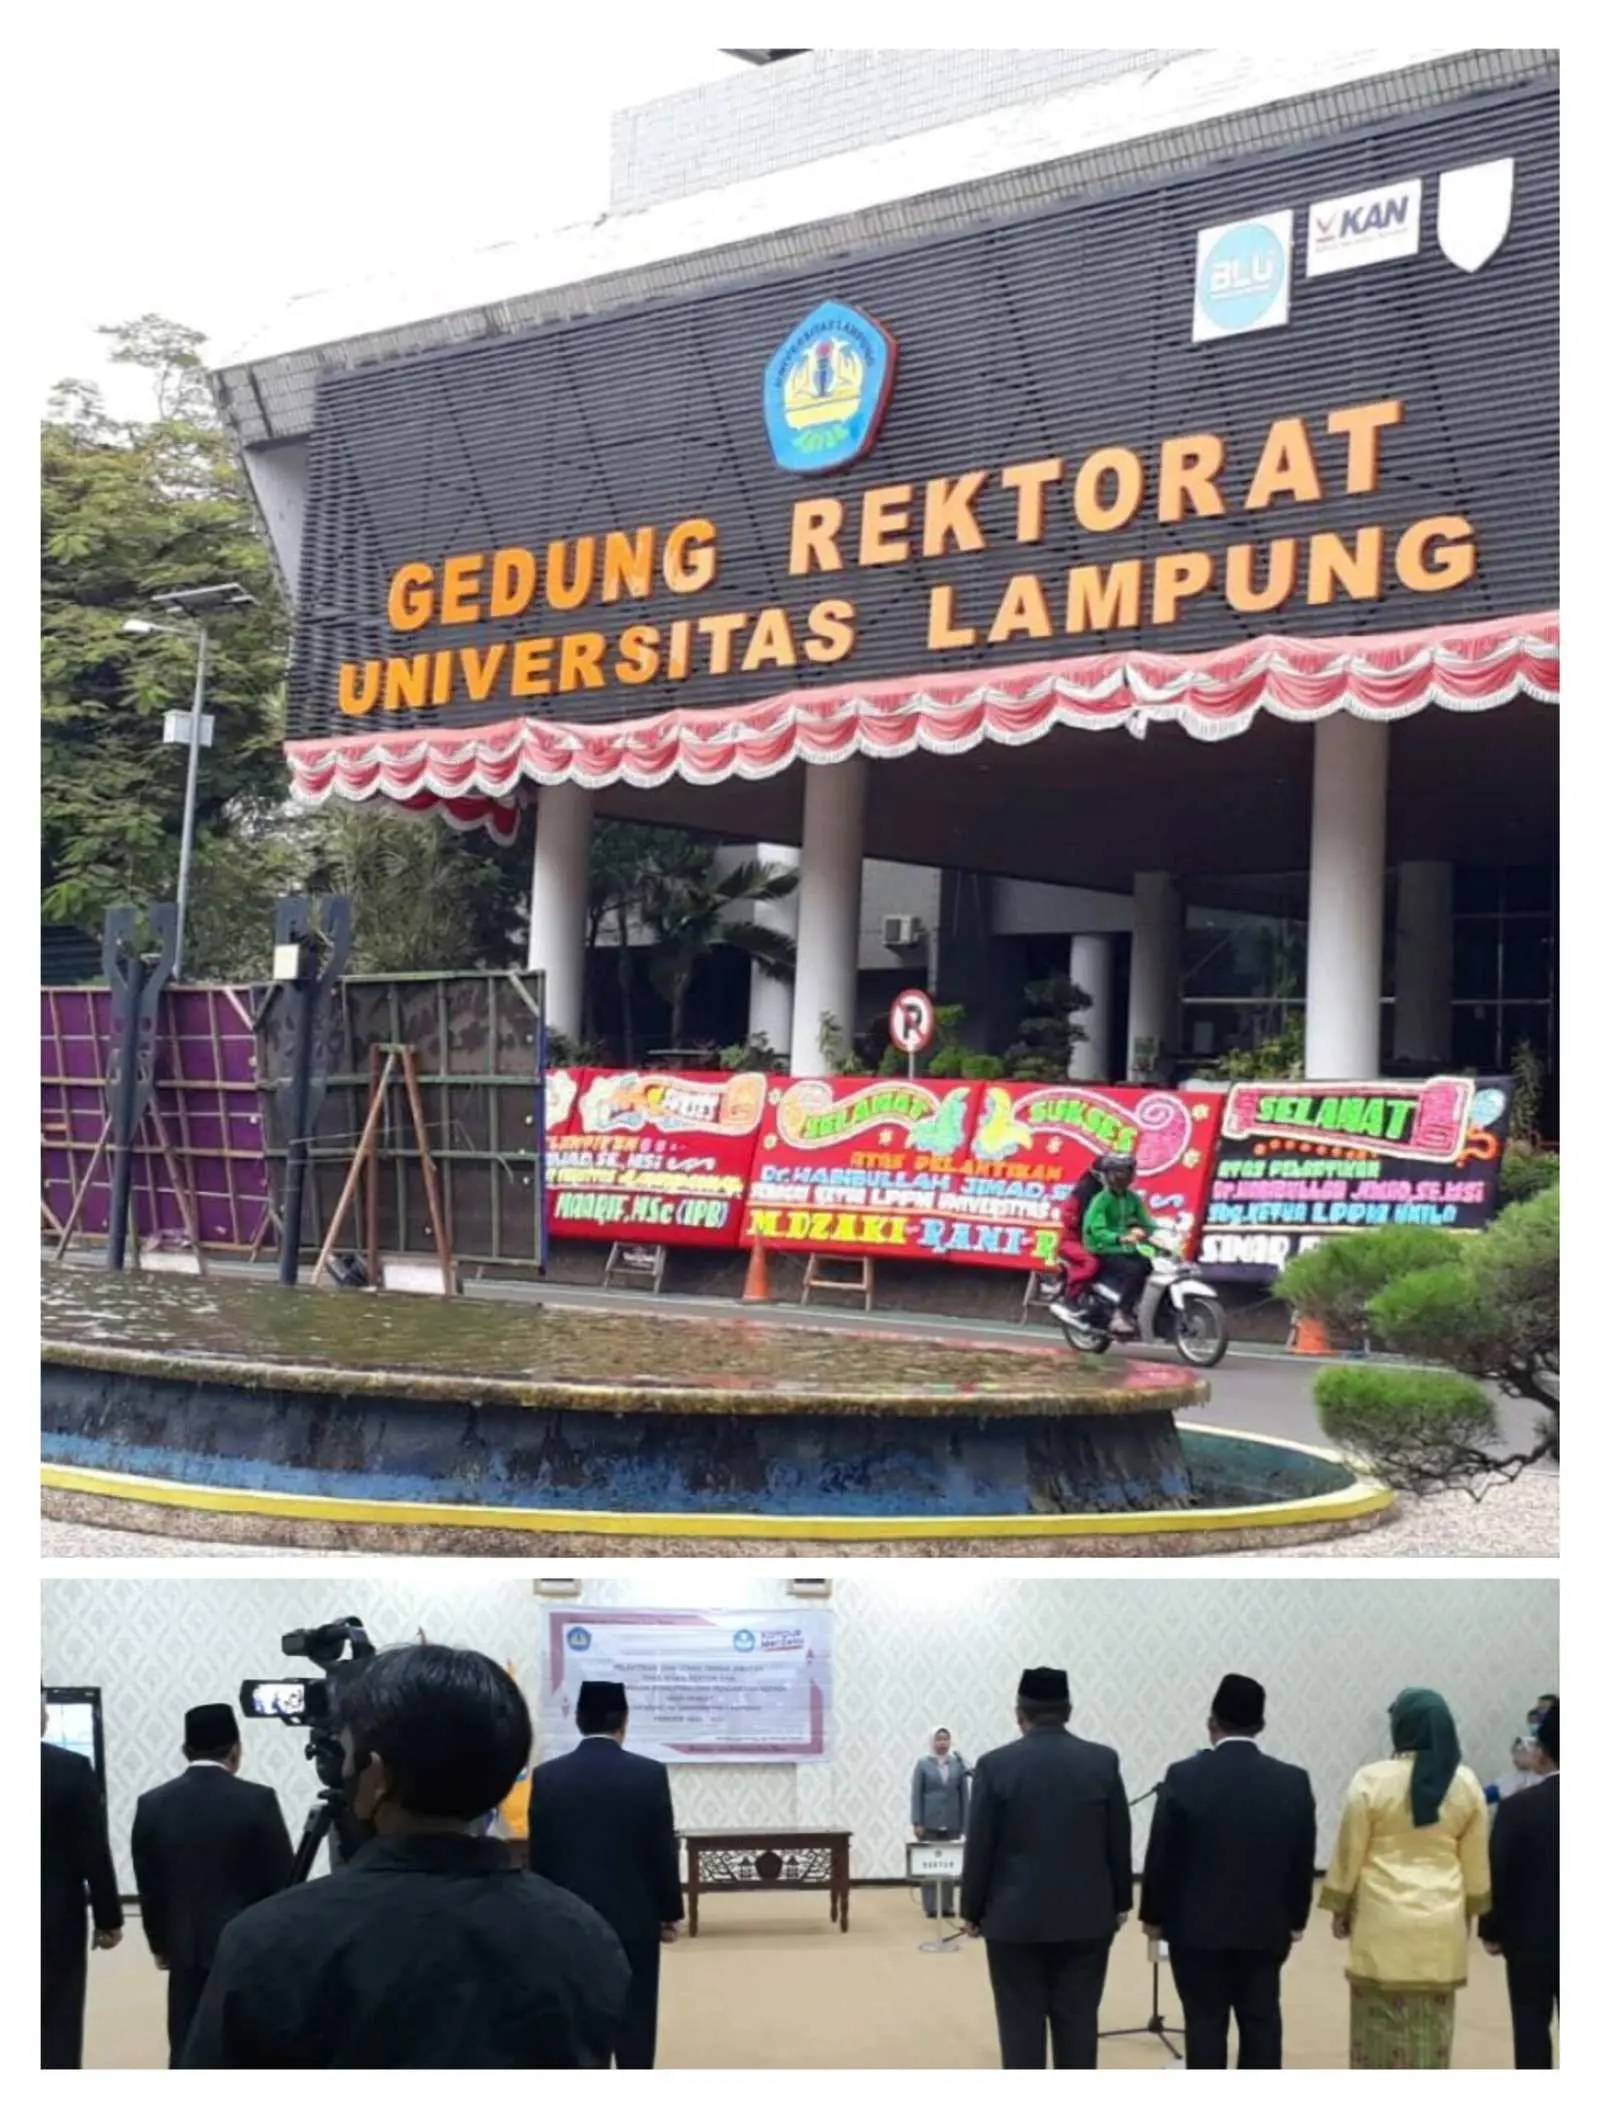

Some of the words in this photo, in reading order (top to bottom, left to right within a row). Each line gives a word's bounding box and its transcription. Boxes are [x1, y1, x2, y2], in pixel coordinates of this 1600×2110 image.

[1340, 195, 1409, 238] KAN
[1210, 252, 1273, 291] BLU
[387, 518, 718, 631] GEDUNG
[788, 401, 1404, 576] REKTORAT
[338, 599, 857, 716] UNIVERSITAS
[926, 515, 1477, 650] LAMPUNG
[1028, 1098, 1138, 1153] SUKSES
[1256, 1096, 1418, 1139] SELAMAT
